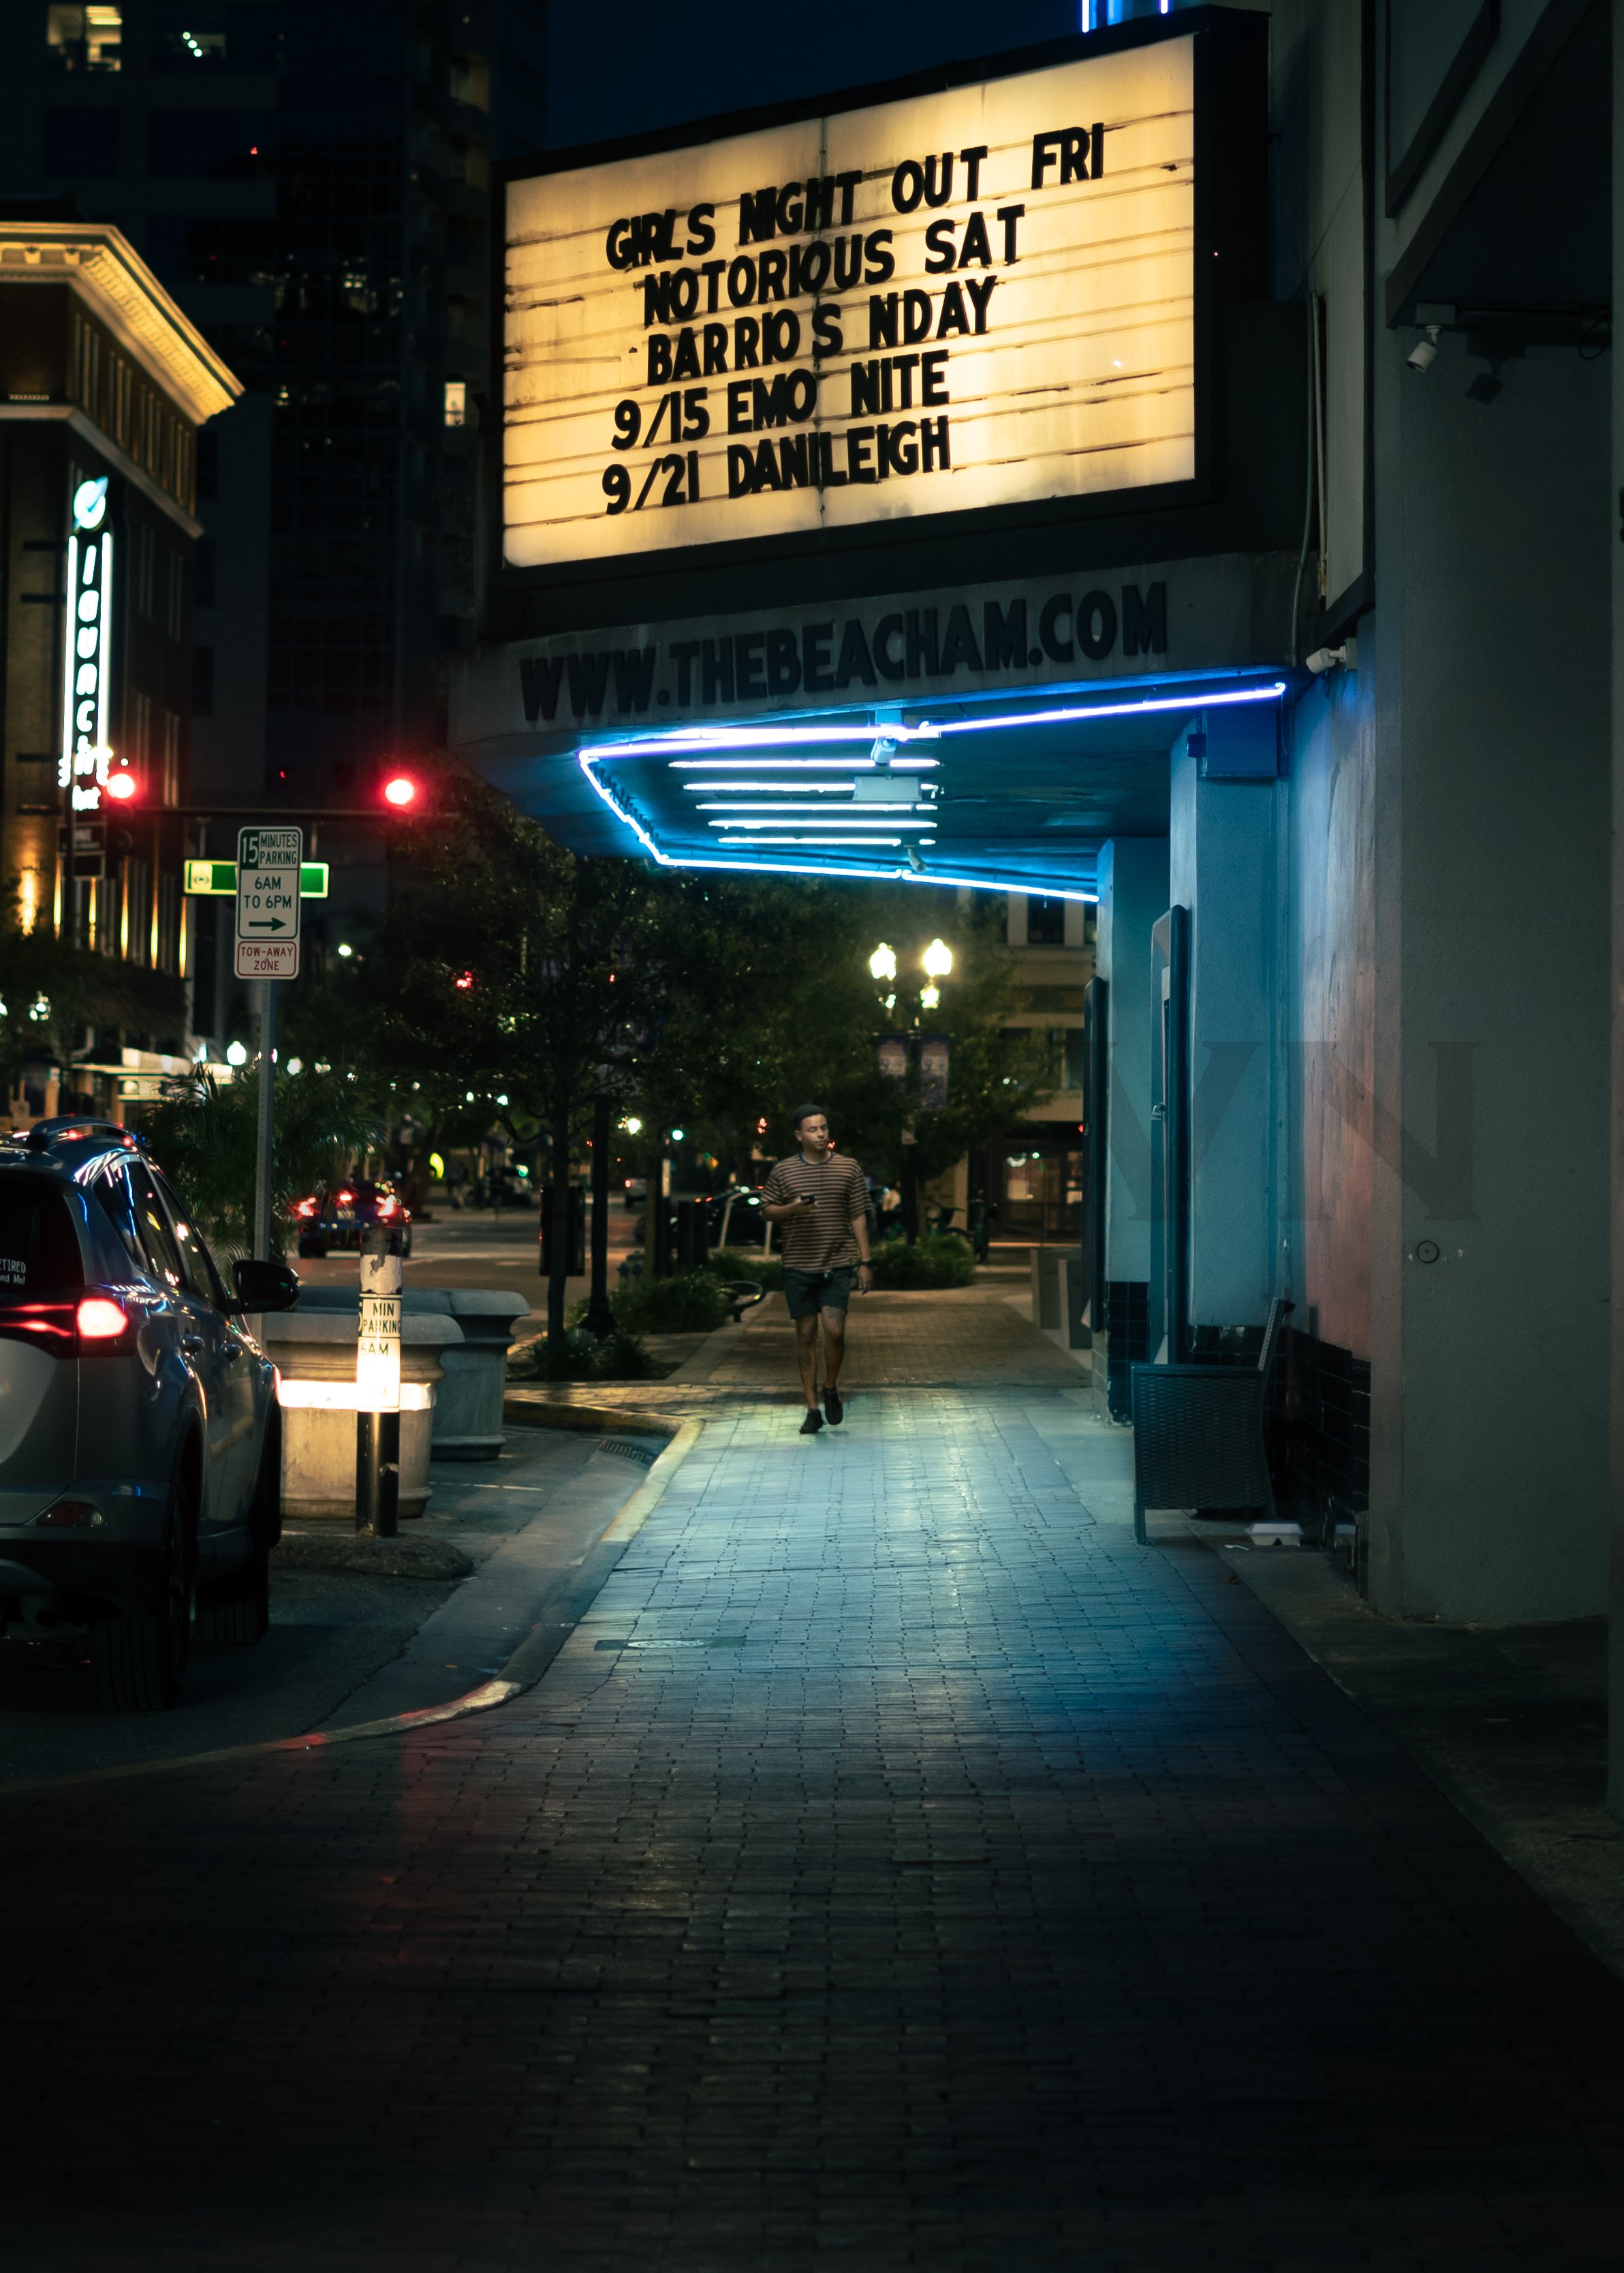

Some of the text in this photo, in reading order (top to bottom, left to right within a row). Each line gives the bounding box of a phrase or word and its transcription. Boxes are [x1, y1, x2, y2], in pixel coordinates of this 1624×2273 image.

[606, 123, 1104, 270] GIRLS NIGHT OUT FRI
[644, 204, 1026, 328] NOTORIOUS SAT
[647, 309, 800, 386] BARRIO
[611, 349, 950, 451] 9/15 EMO NITE
[602, 415, 950, 515] 9/21 DANILEIGH
[519, 581, 1168, 721] WWW.THEBEACHAM.COM
[260, 834, 298, 848] MINUTES
[243, 836, 259, 864] 15
[260, 851, 297, 864] PARKING
[255, 876, 281, 890] 6AM
[244, 895, 292, 909] TO 6PM
[240, 947, 294, 957] TOW-AWAY
[254, 961, 279, 971] ZONE
[373, 1302, 394, 1317] MIN
[360, 1343, 389, 1356] 6AM
